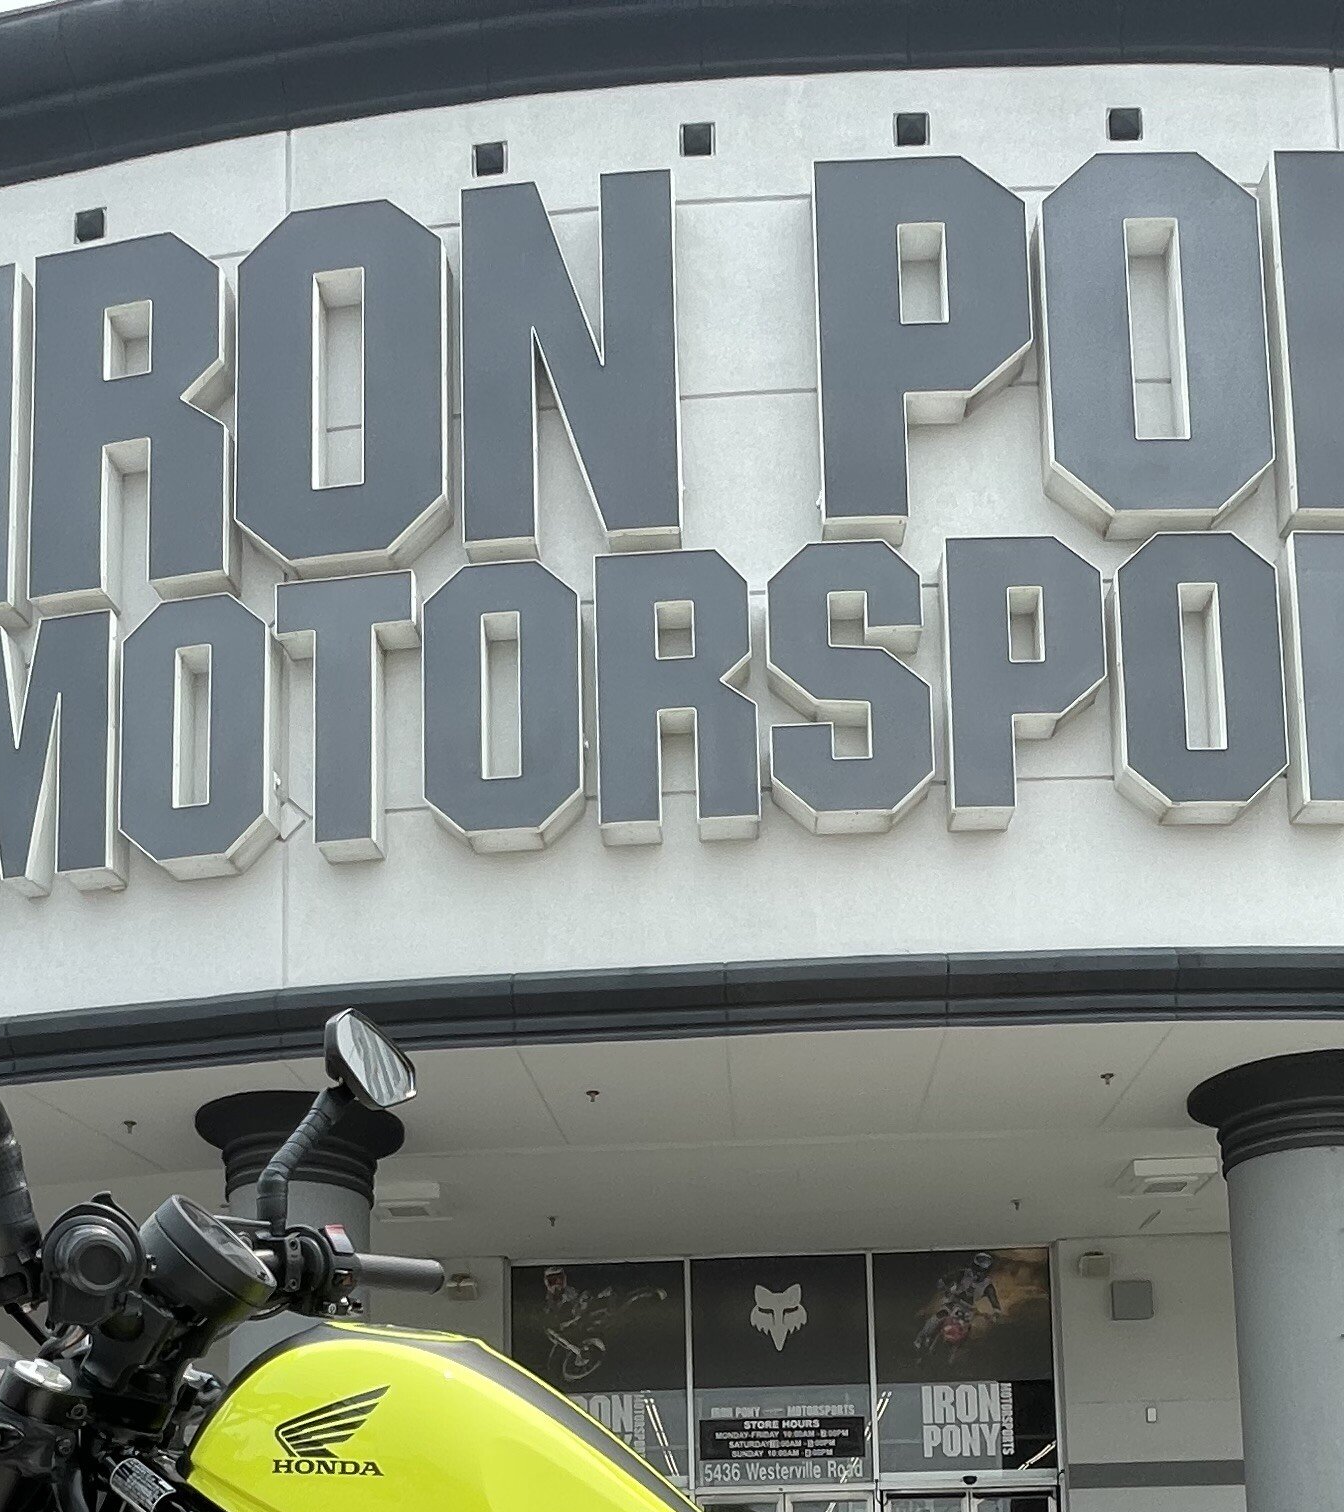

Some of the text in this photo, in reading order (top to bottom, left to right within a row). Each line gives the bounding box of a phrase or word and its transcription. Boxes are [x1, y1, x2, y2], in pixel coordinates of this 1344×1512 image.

[921, 1384, 1001, 1424] IRON
[743, 1419, 821, 1430] STORE HOURS
[923, 1424, 1001, 1458] PONY
[272, 1459, 384, 1476] HONDA
[704, 1459, 863, 1482] 5436 Westerville Road
